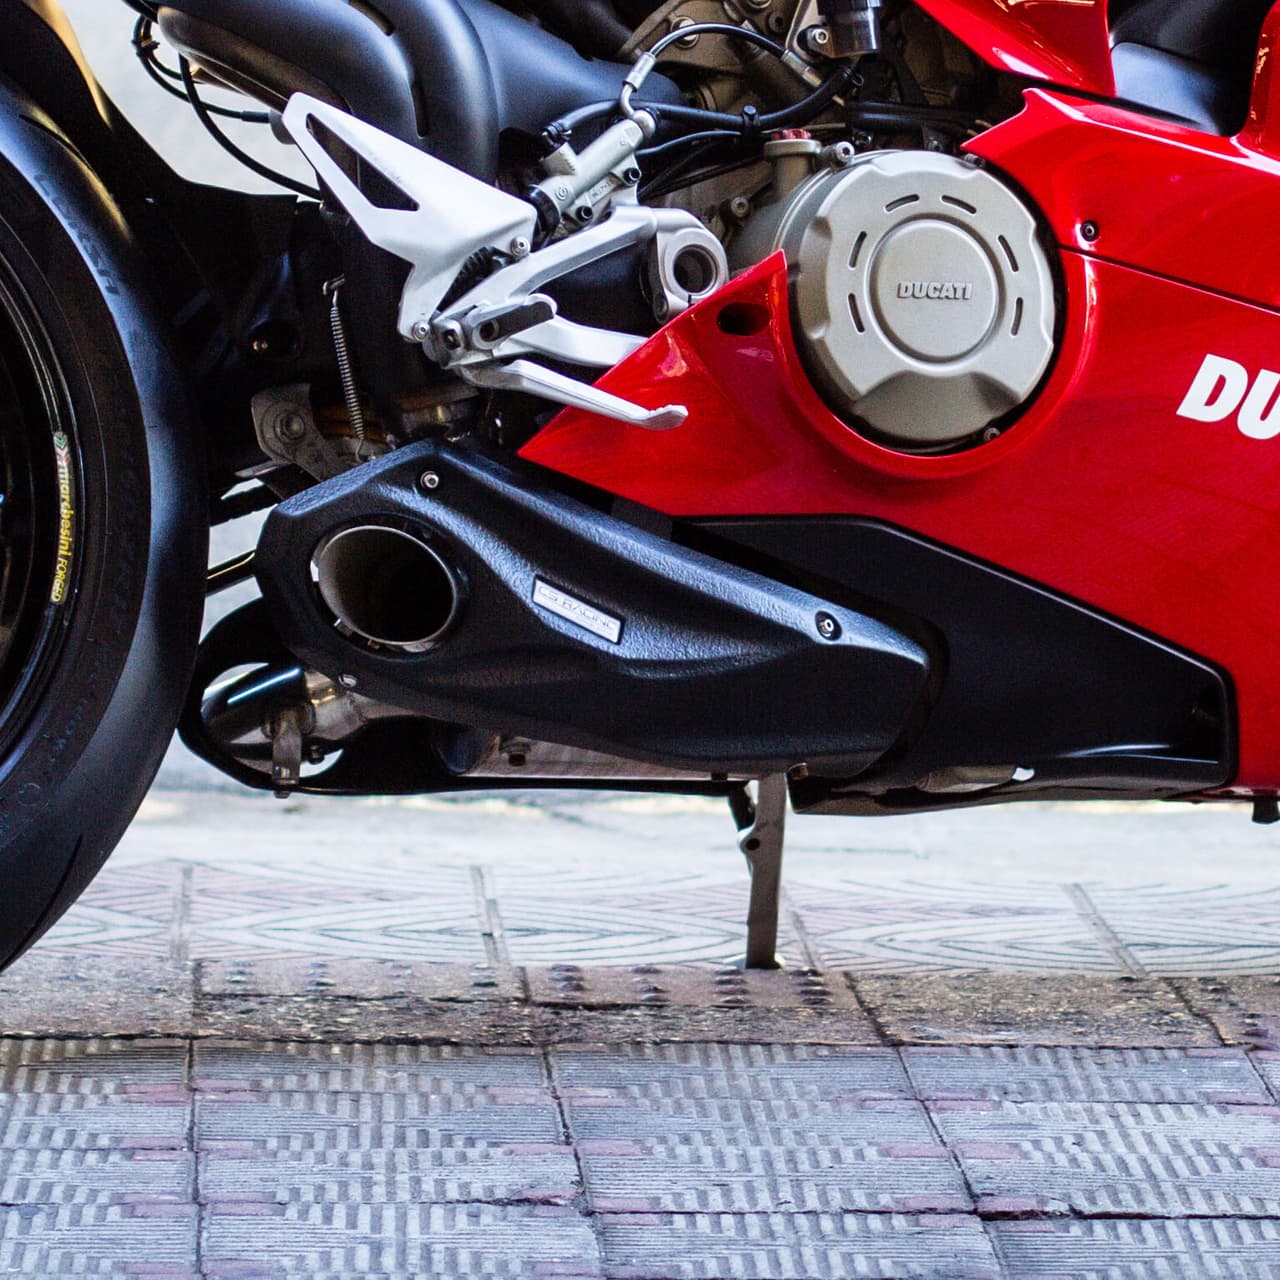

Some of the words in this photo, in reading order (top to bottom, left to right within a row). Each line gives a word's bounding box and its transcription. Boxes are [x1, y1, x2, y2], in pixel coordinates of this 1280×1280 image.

[897, 281, 973, 300] DUCATI
[58, 462, 75, 557] marchesini
[51, 557, 68, 602] FORGED
